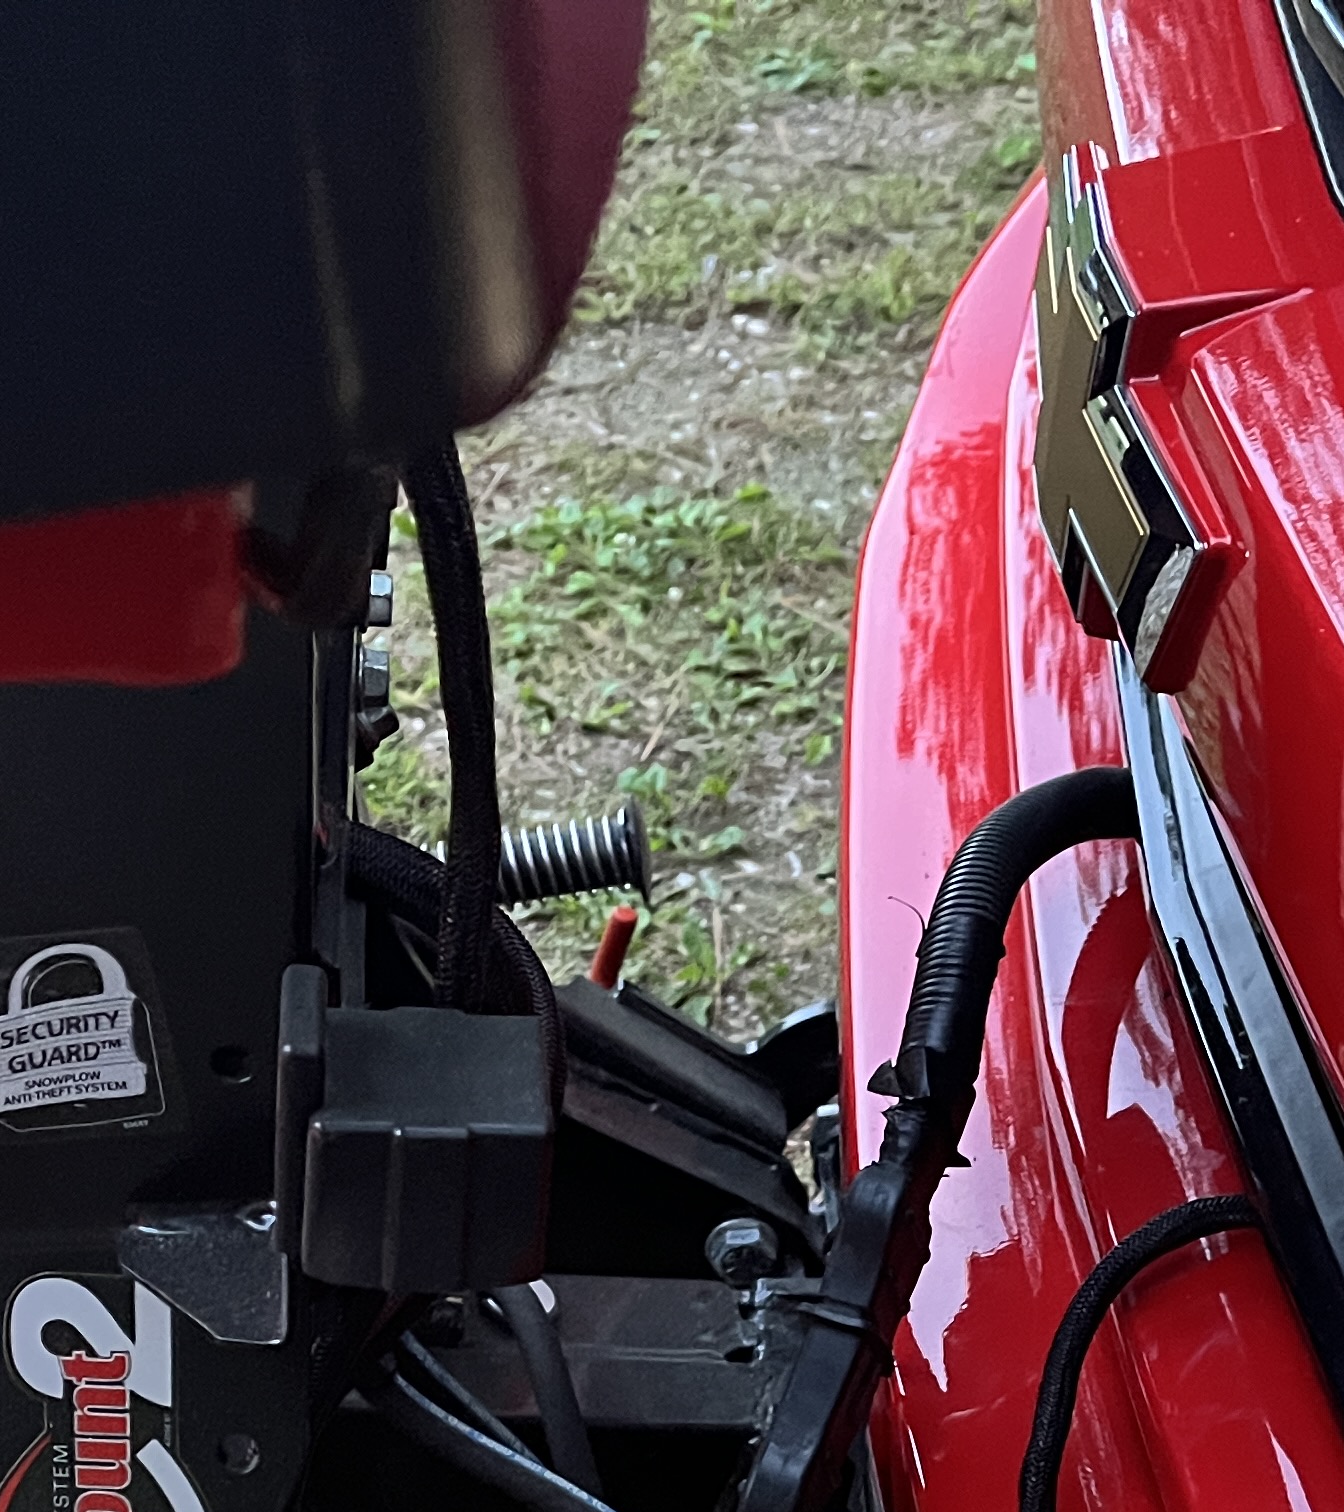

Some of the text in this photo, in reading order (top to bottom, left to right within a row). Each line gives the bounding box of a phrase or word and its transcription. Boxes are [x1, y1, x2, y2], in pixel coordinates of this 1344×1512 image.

[0, 1010, 119, 1049] SECURITY
[24, 1071, 101, 1090] SNOWPLOW
[75, 1081, 127, 1095] SYSTEM
